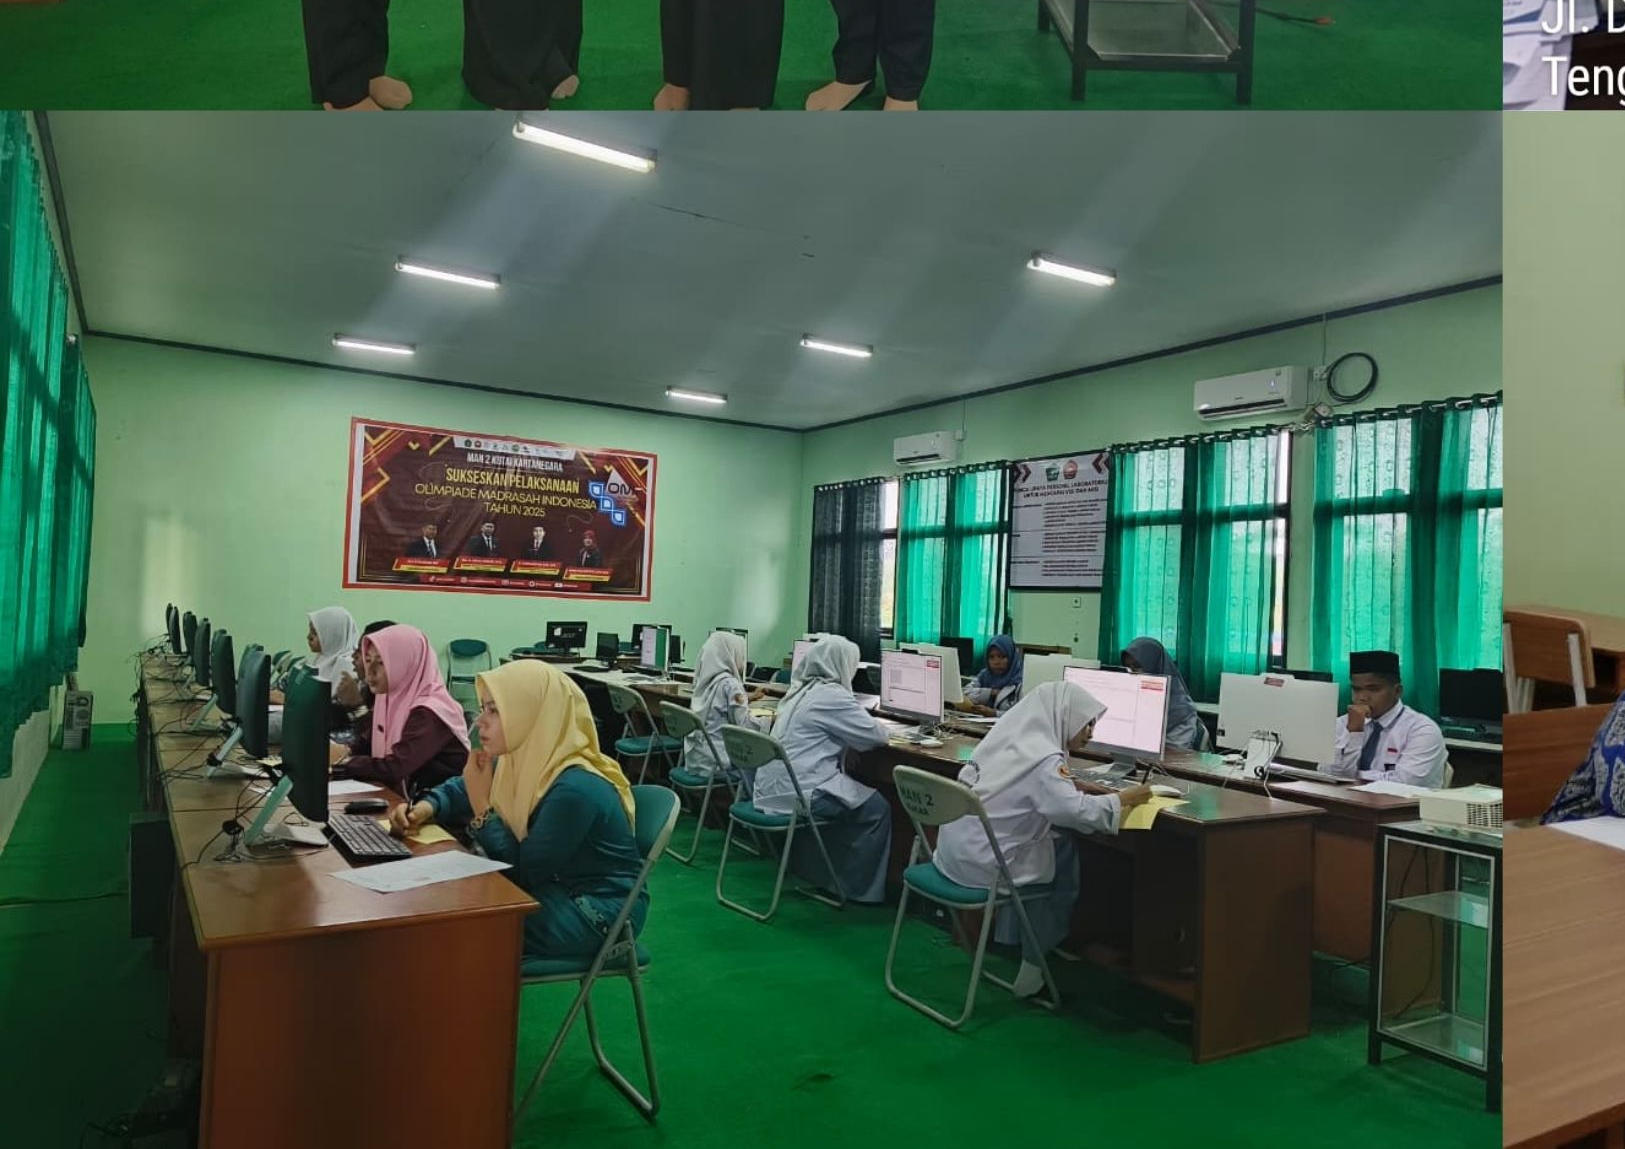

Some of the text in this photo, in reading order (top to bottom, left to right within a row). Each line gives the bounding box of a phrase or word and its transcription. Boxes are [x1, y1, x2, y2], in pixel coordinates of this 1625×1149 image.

[467, 453, 485, 463] MAN
[485, 454, 491, 463] 2
[514, 458, 563, 472] KARTANEGARA
[446, 468, 580, 494] SUKSESKAN PELAKSANAAN
[415, 483, 597, 510] OLIMPIADE MADRASAH INDONESIA
[483, 501, 545, 517] TAHUN 2025
[924, 794, 934, 806] 2
